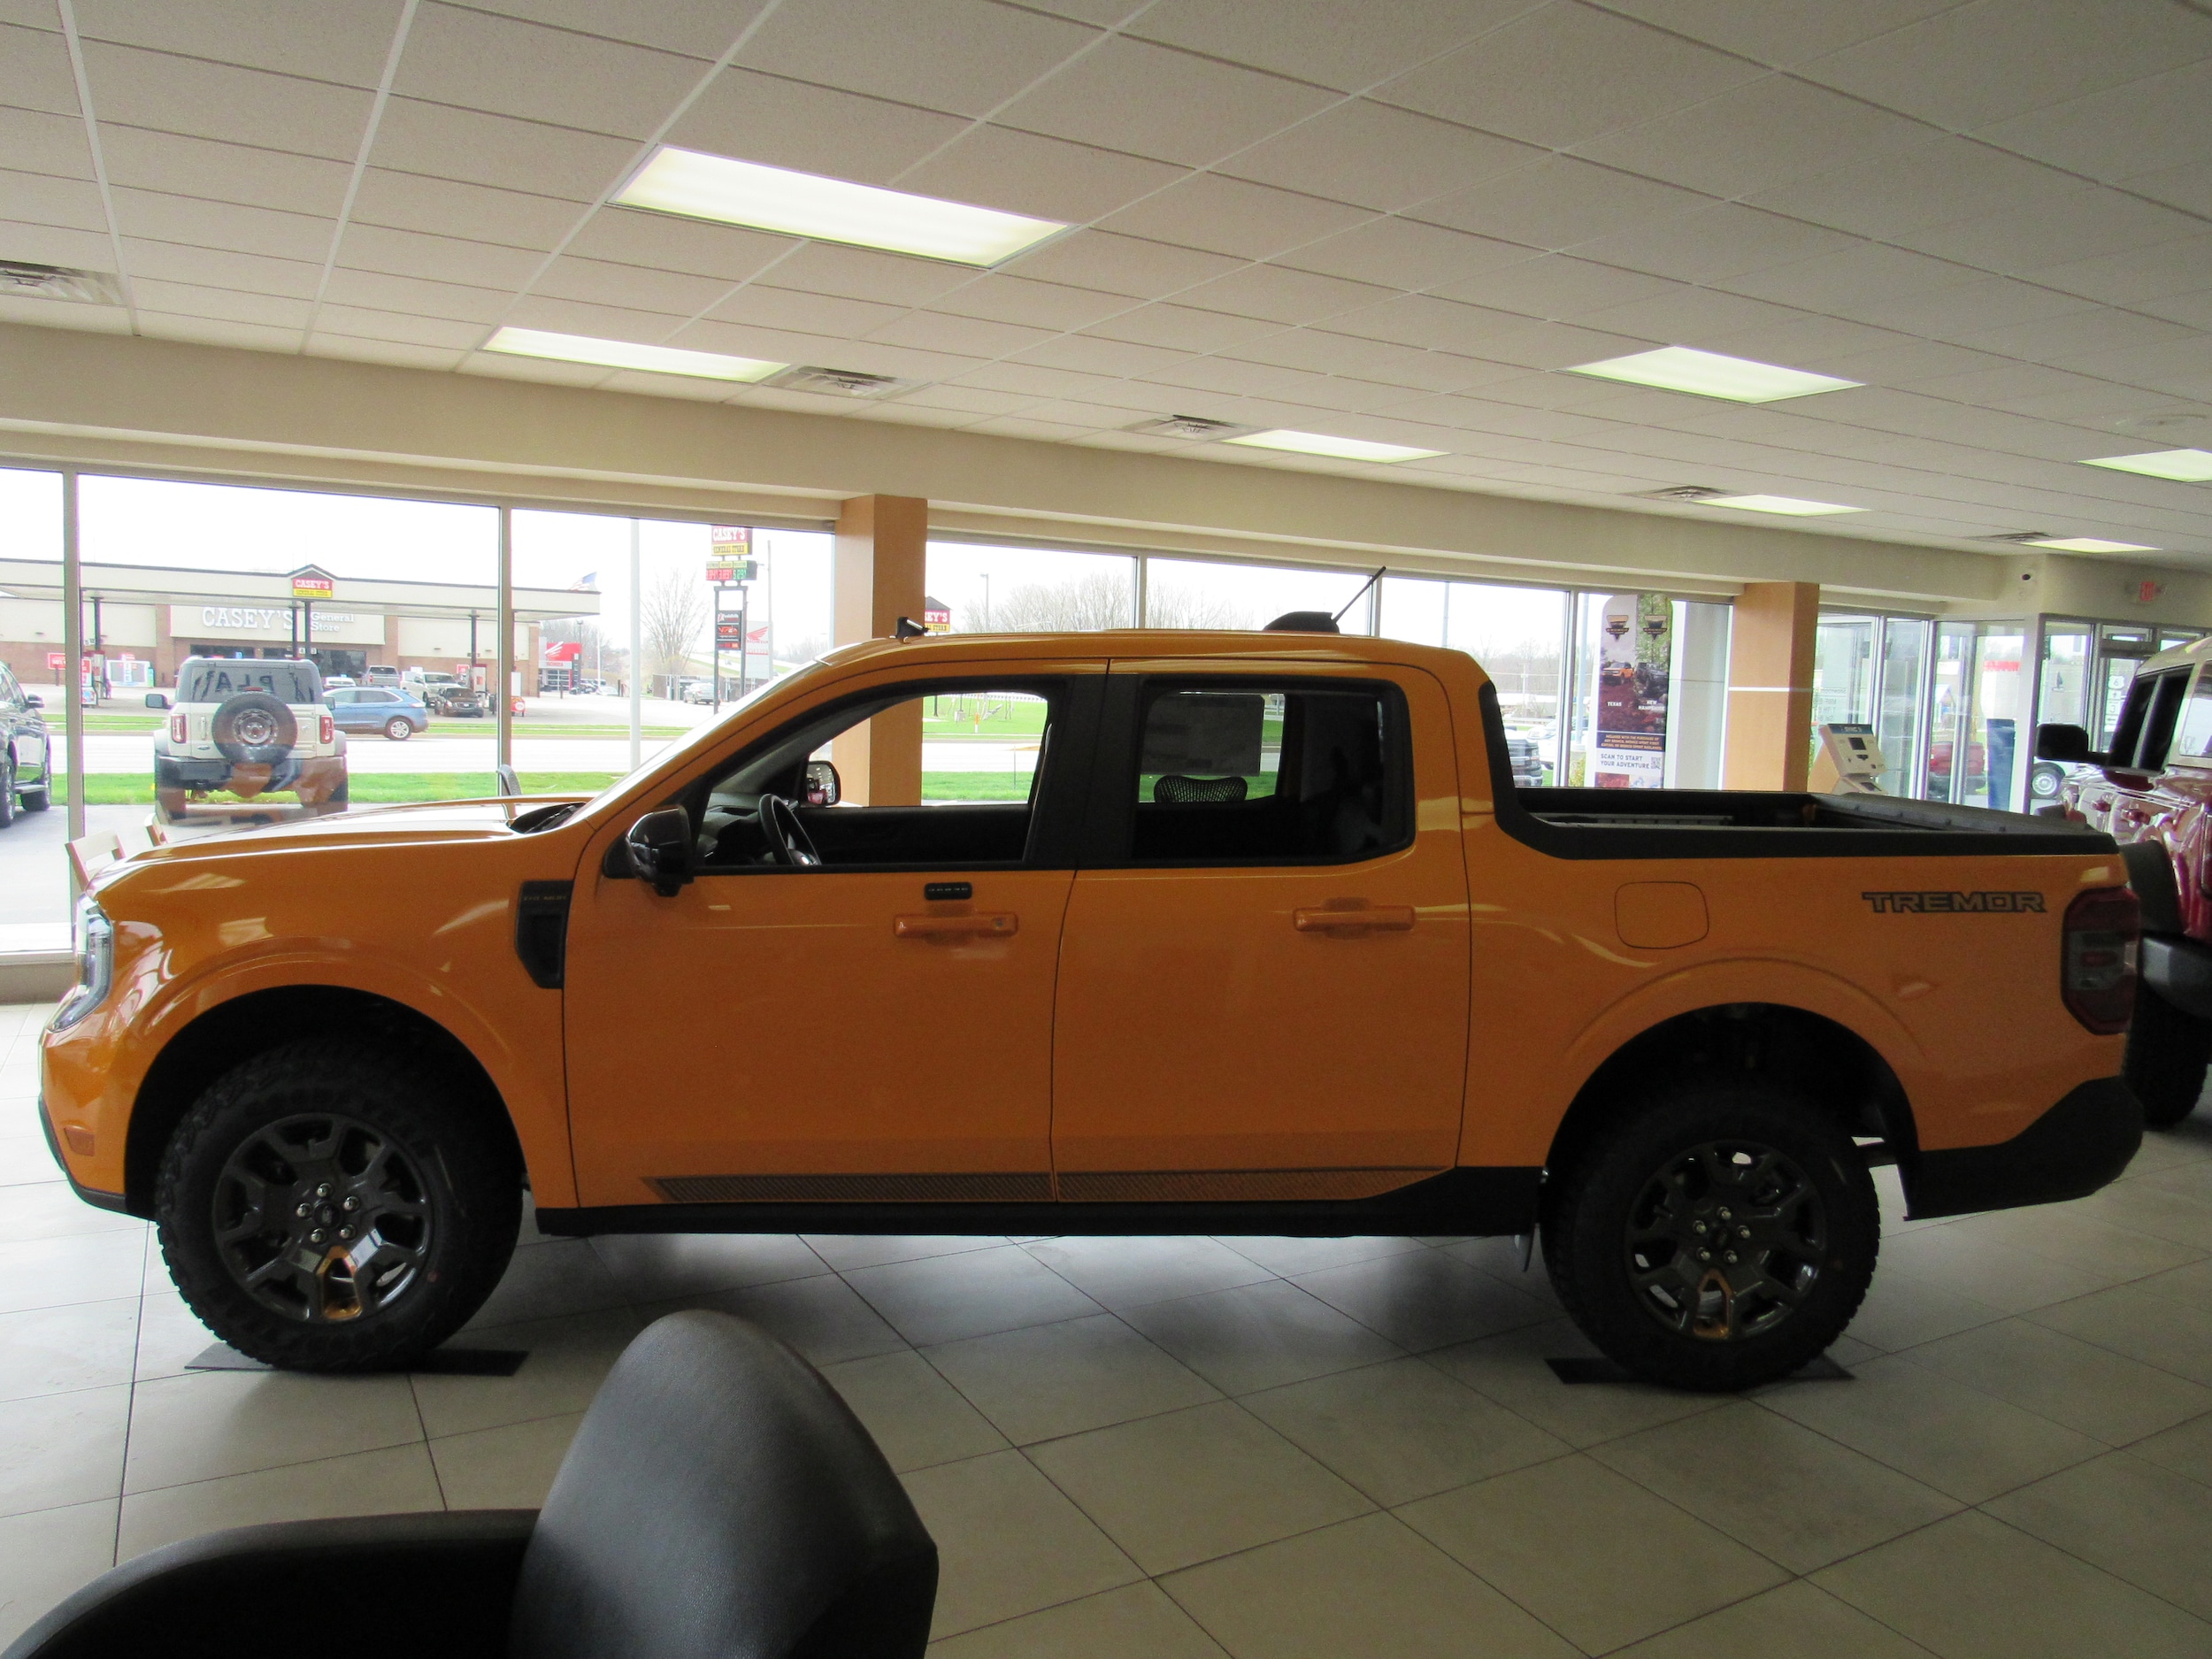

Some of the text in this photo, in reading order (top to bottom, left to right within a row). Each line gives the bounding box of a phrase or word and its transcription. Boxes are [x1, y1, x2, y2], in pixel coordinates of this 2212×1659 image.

[713, 527, 745, 542] CASEY'S
[295, 580, 330, 590] CASEY'S
[202, 607, 294, 630] CASEY'S
[311, 611, 354, 624] General
[311, 621, 341, 632] Store
[1861, 891, 2048, 913] TREMOR
